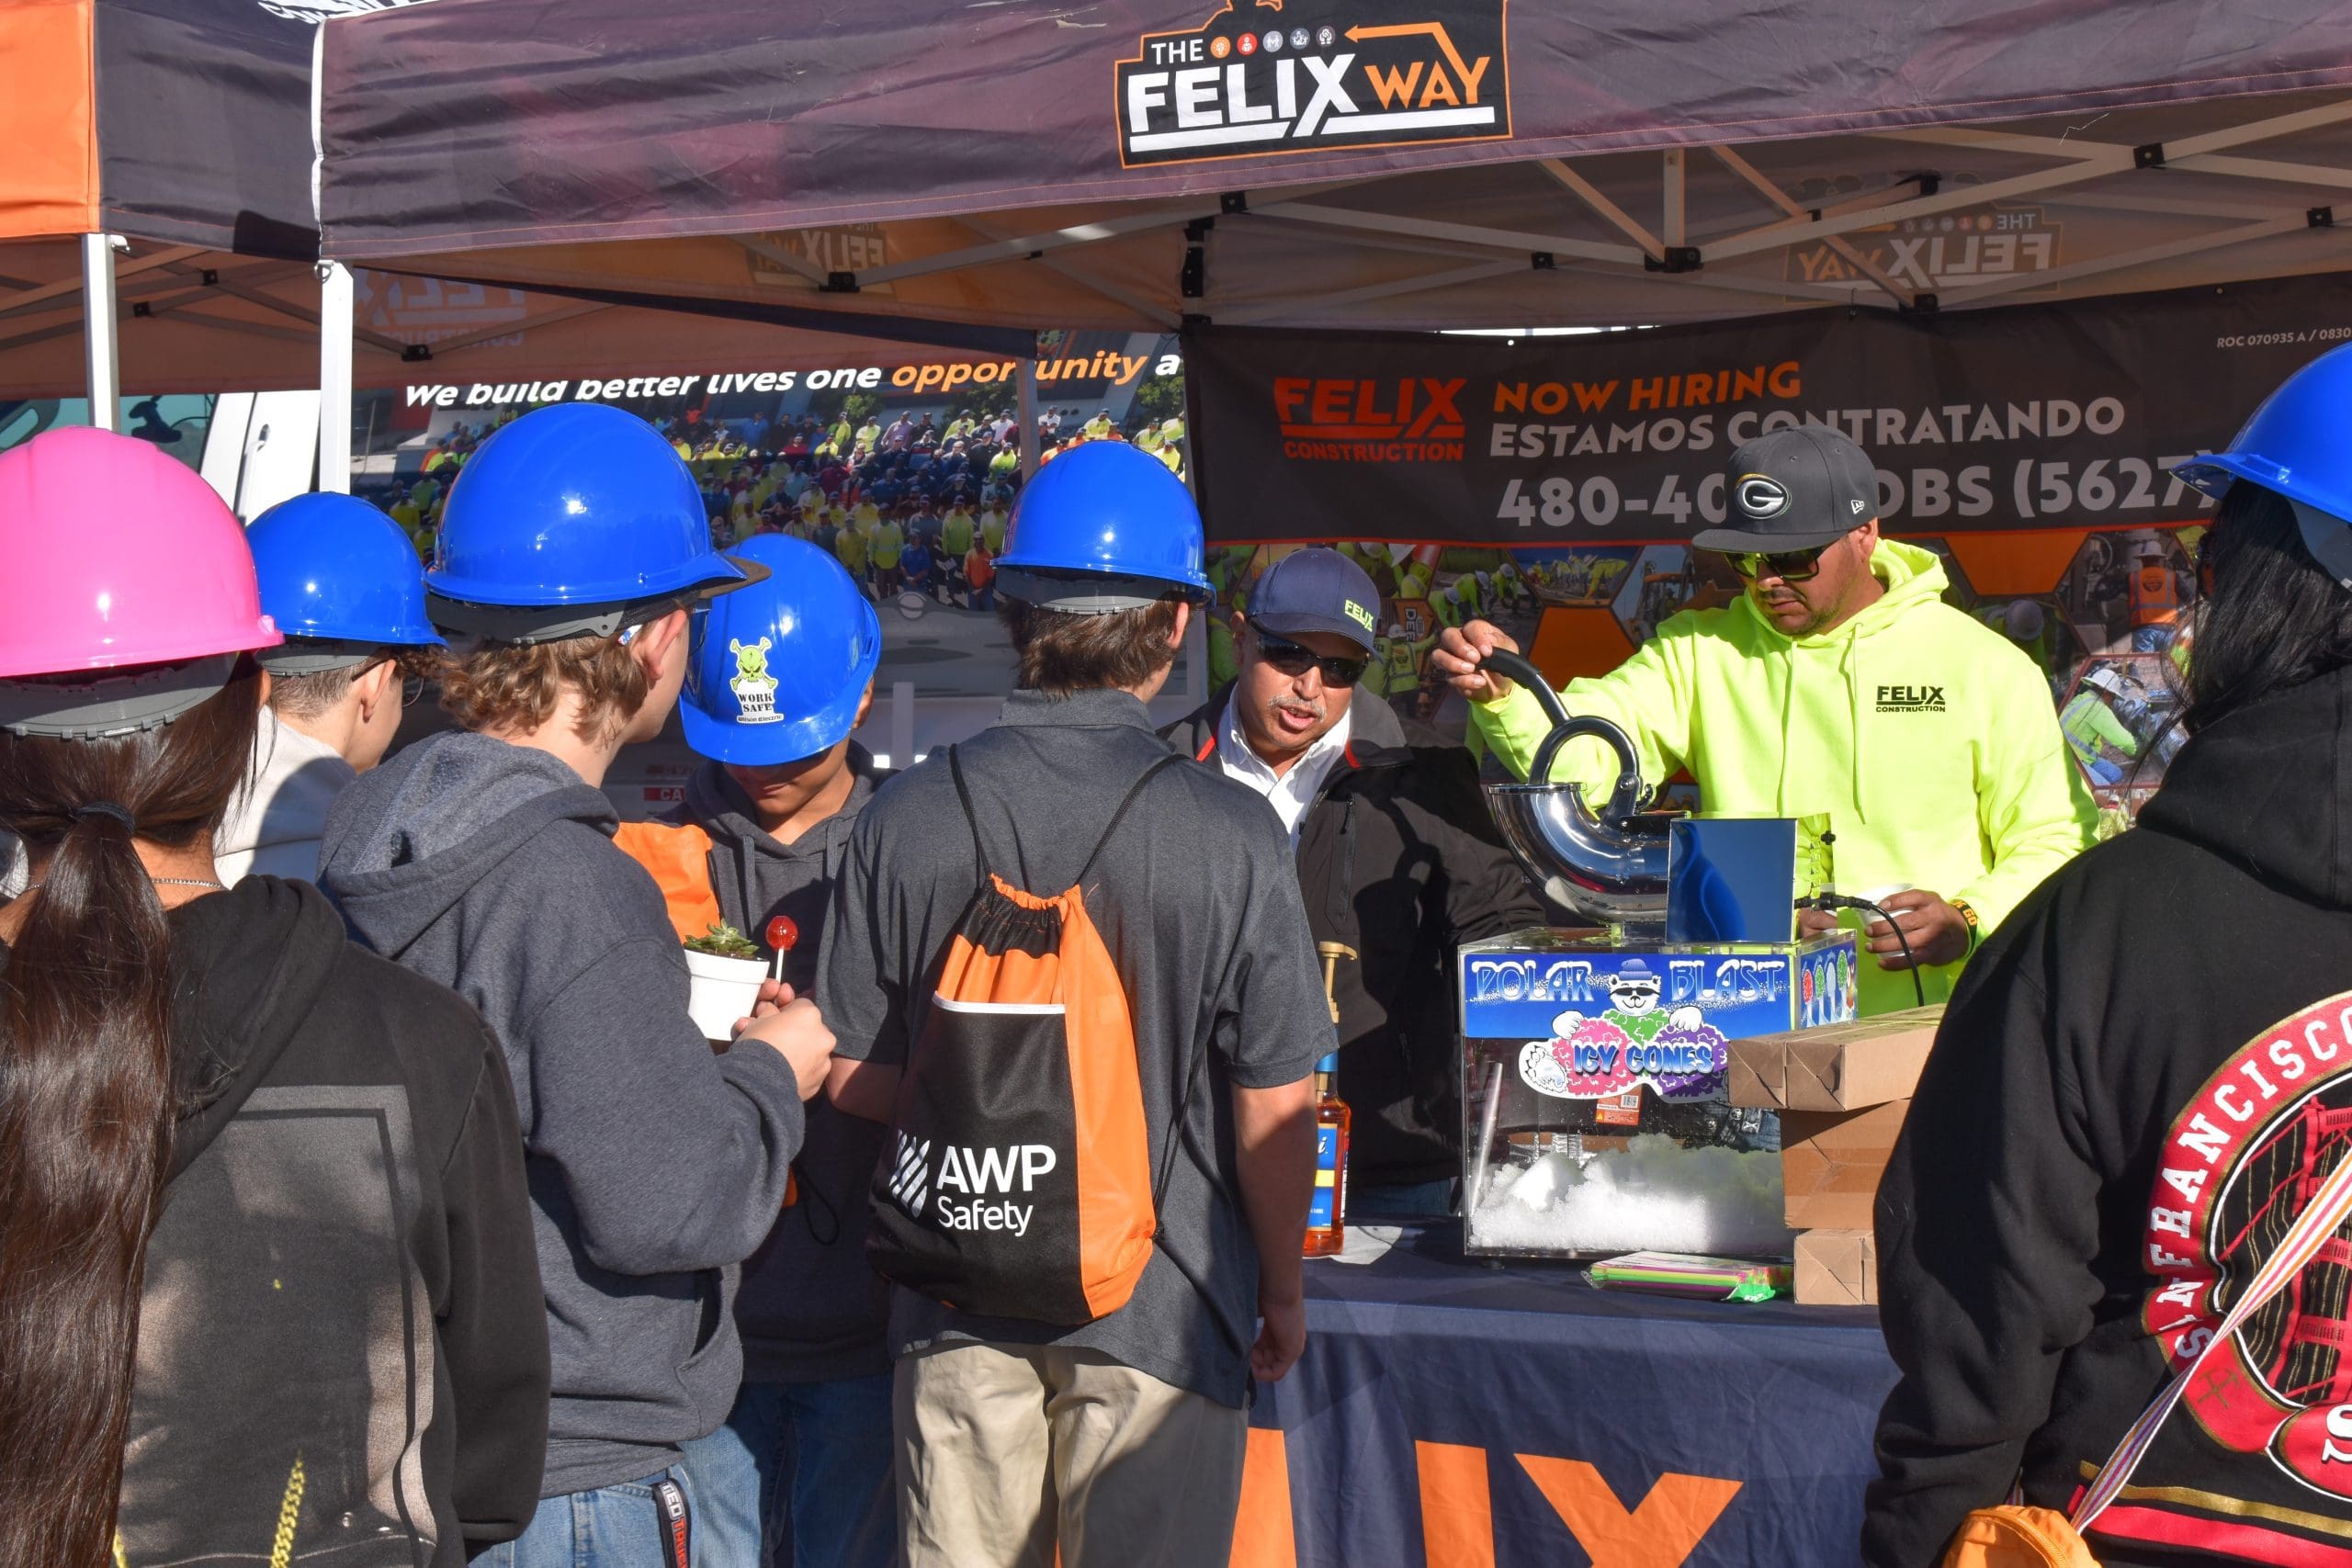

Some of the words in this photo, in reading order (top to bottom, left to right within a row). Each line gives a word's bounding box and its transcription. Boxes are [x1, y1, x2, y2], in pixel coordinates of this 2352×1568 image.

[1151, 39, 1204, 64] THE
[1127, 53, 1360, 138] FELIX
[1364, 56, 1491, 110] WAY
[2217, 335, 2245, 348] ROC
[2247, 332, 2294, 346] 070935
[2297, 332, 2306, 343] A
[406, 383, 458, 407] We
[575, 373, 700, 401] better
[707, 370, 795, 394] lives
[806, 367, 882, 390] one
[891, 350, 1148, 393] opporunity
[1494, 380, 1620, 414] NOW
[1628, 361, 1801, 412] HIRING
[1273, 377, 1467, 438] FELIX
[1284, 441, 1464, 461] CONSTRUCTION
[1490, 414, 1714, 458] ESTAMOS
[1345, 598, 1374, 630] FELIX
[739, 693, 773, 703] WORK
[742, 703, 773, 713] SAFE
[1877, 685, 1944, 705] FELIX
[1472, 960, 1595, 1002] POLAR
[1668, 960, 1785, 1002] BLAST
[1572, 1043, 1620, 1075] ICY
[1625, 1043, 1714, 1075] CONES
[936, 1145, 1057, 1194] AWP
[937, 1195, 1034, 1237] Safety
